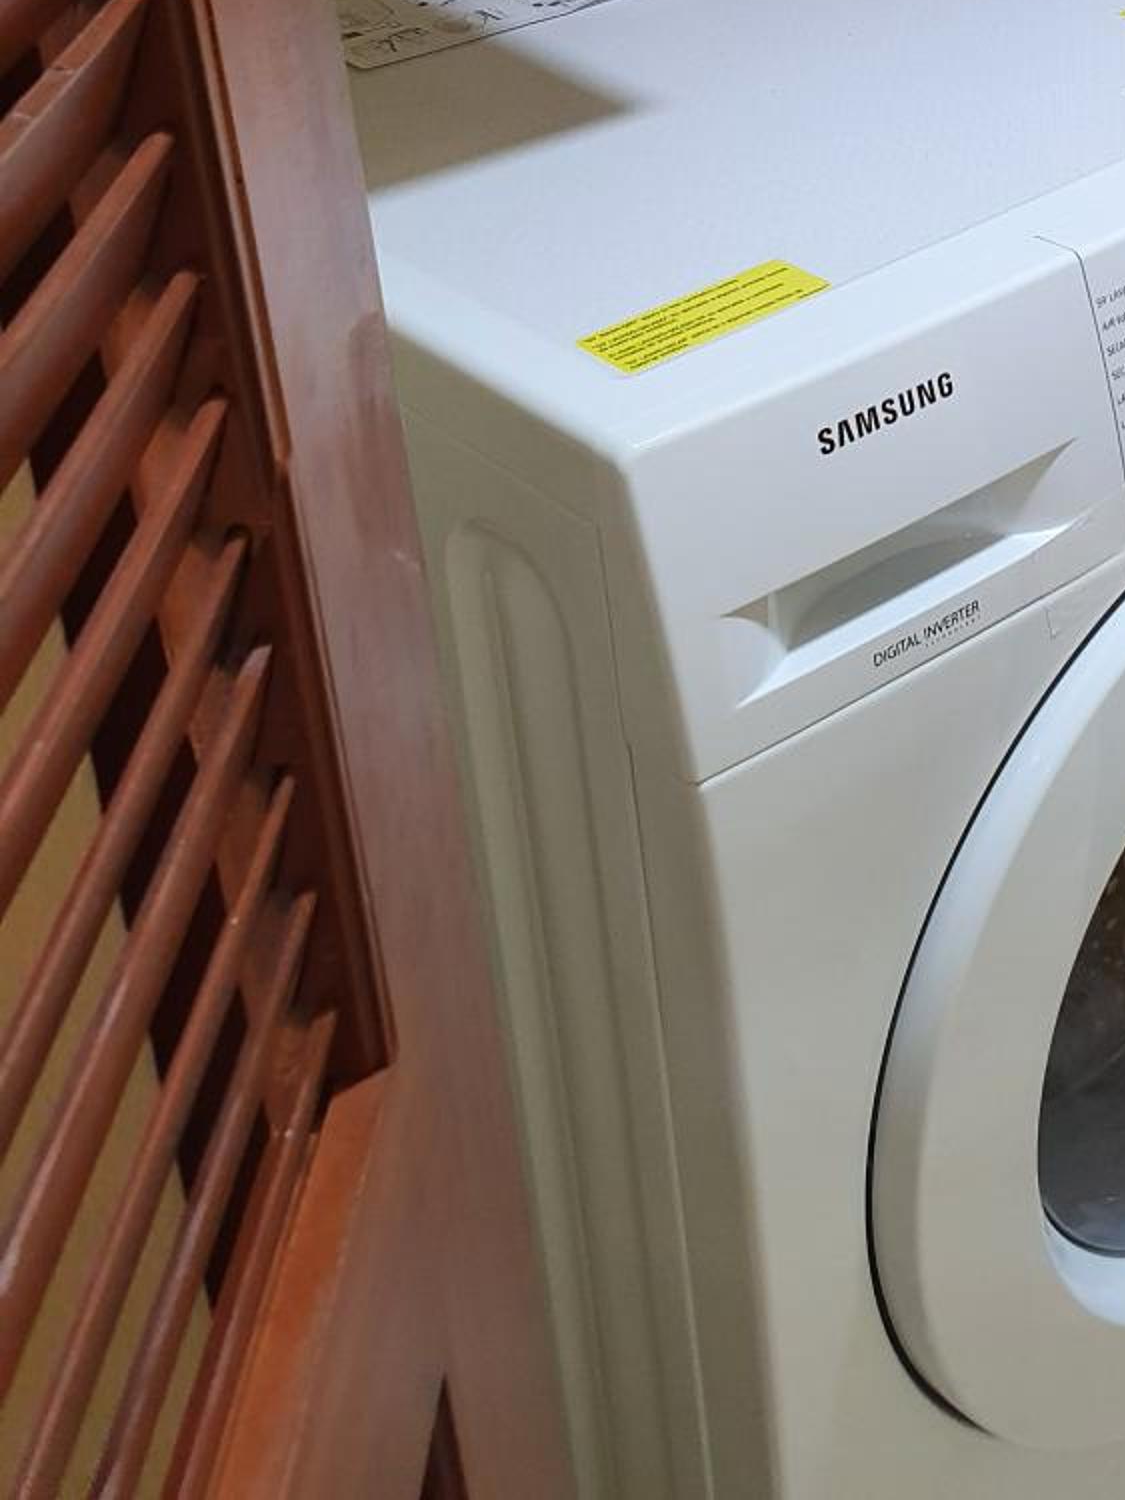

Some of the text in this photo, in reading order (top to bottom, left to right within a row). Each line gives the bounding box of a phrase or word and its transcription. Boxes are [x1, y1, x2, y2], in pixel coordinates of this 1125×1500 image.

[816, 371, 956, 455] SAMSUNG
[873, 632, 922, 667] DIGITAL
[923, 599, 981, 639] INVERTER
